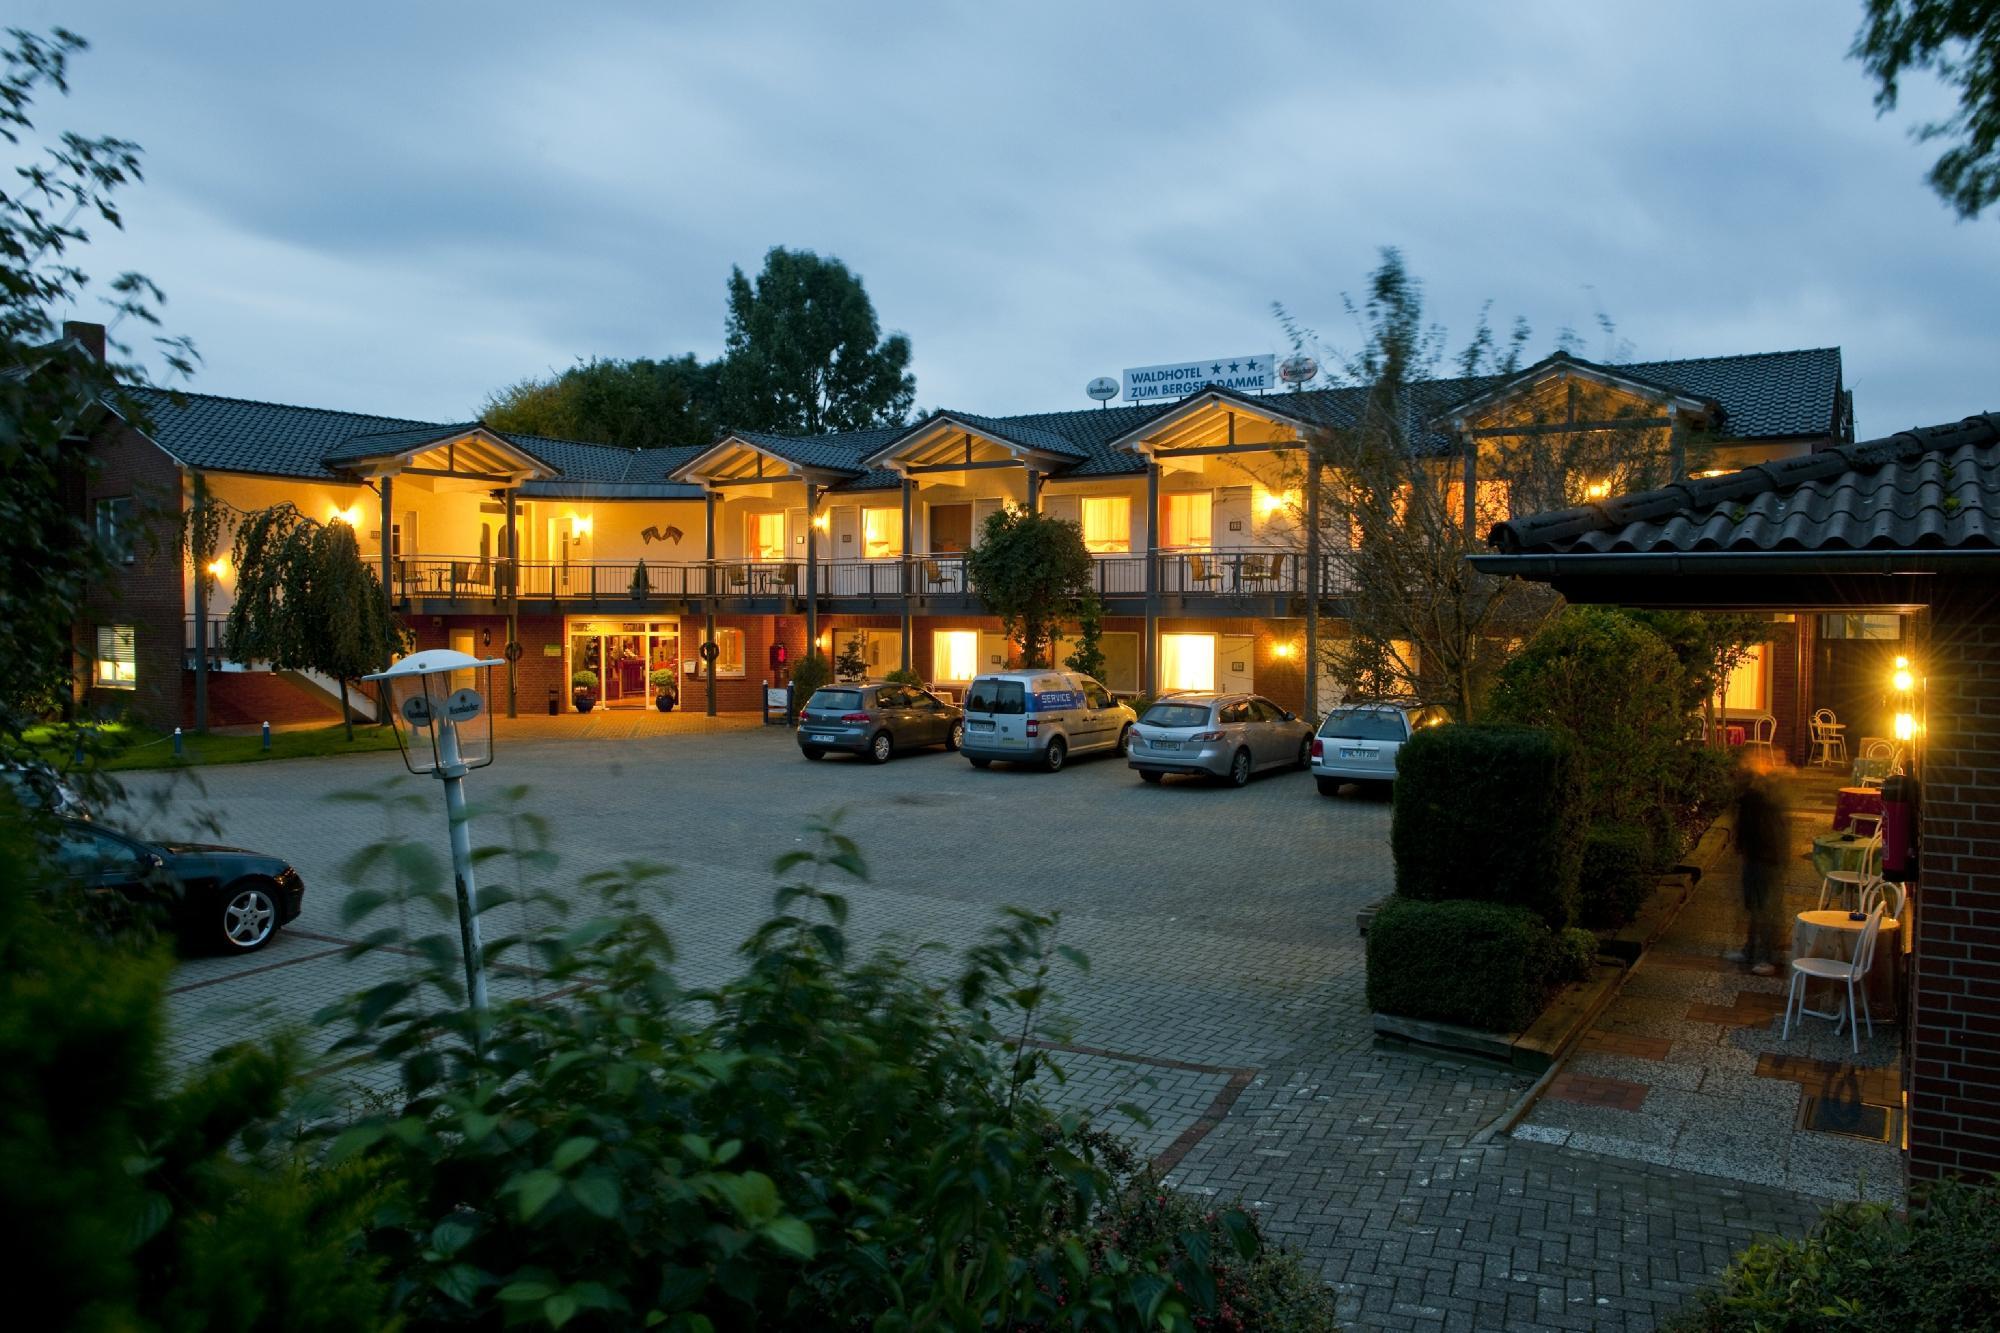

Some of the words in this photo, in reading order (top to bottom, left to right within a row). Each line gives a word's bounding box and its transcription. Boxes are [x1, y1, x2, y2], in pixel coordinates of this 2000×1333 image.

[1131, 367, 1202, 384] WALDHOTEL
[1131, 386, 1158, 398] ZUM
[1217, 375, 1264, 388] DAMME
[1041, 693, 1071, 704] SERVICE
